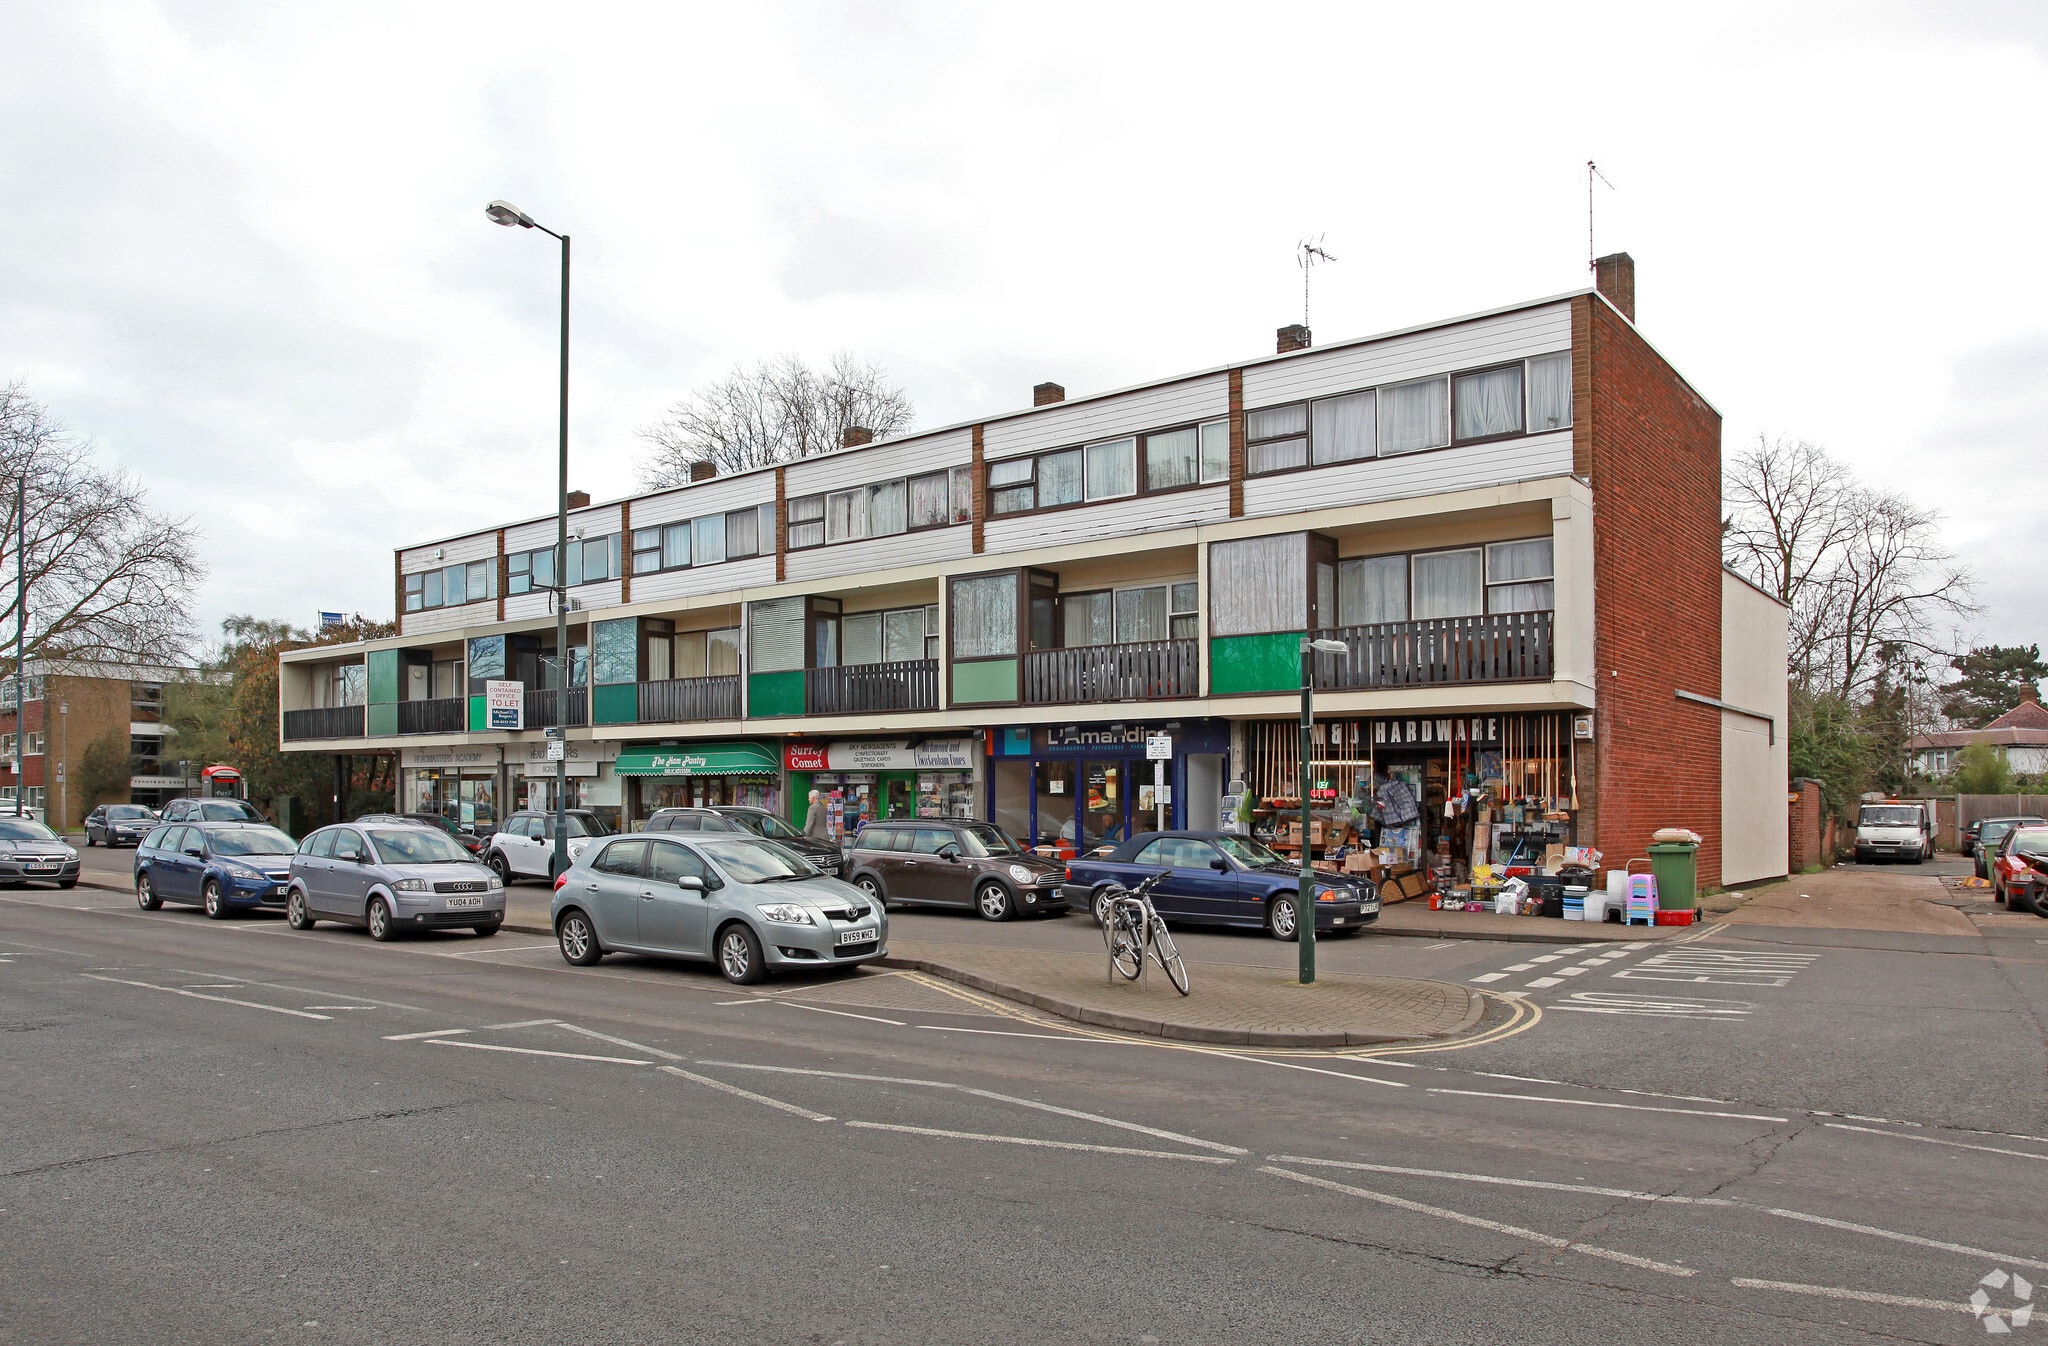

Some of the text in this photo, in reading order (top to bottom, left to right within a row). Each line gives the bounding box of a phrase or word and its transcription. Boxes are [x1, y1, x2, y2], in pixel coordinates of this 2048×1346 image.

[491, 699, 520, 707] TO LET
[1375, 718, 1497, 744] HARDWARE
[652, 755, 707, 767] The Ham Pantry
[791, 757, 823, 769] Comet
